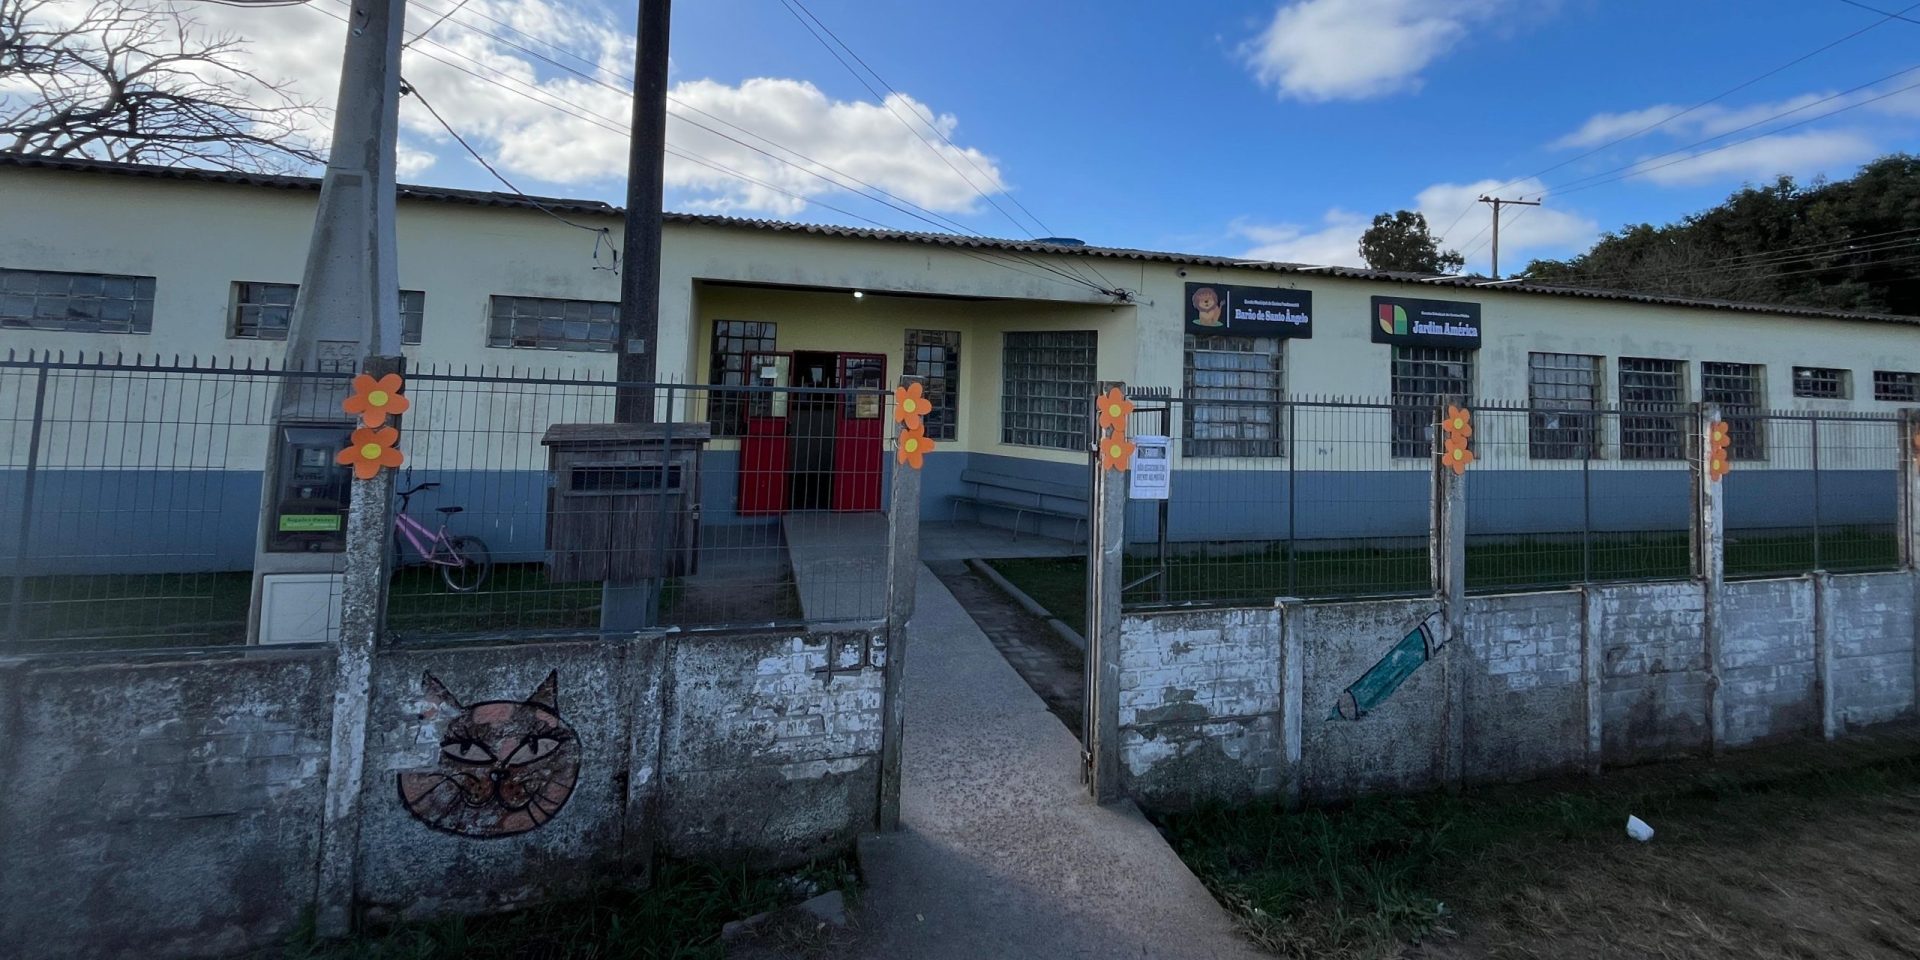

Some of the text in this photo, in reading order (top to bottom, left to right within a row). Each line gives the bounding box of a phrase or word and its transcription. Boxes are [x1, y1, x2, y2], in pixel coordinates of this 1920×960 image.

[1235, 308, 1309, 326] Barão de Santo Ângelo
[1412, 320, 1478, 337] Jardim América
